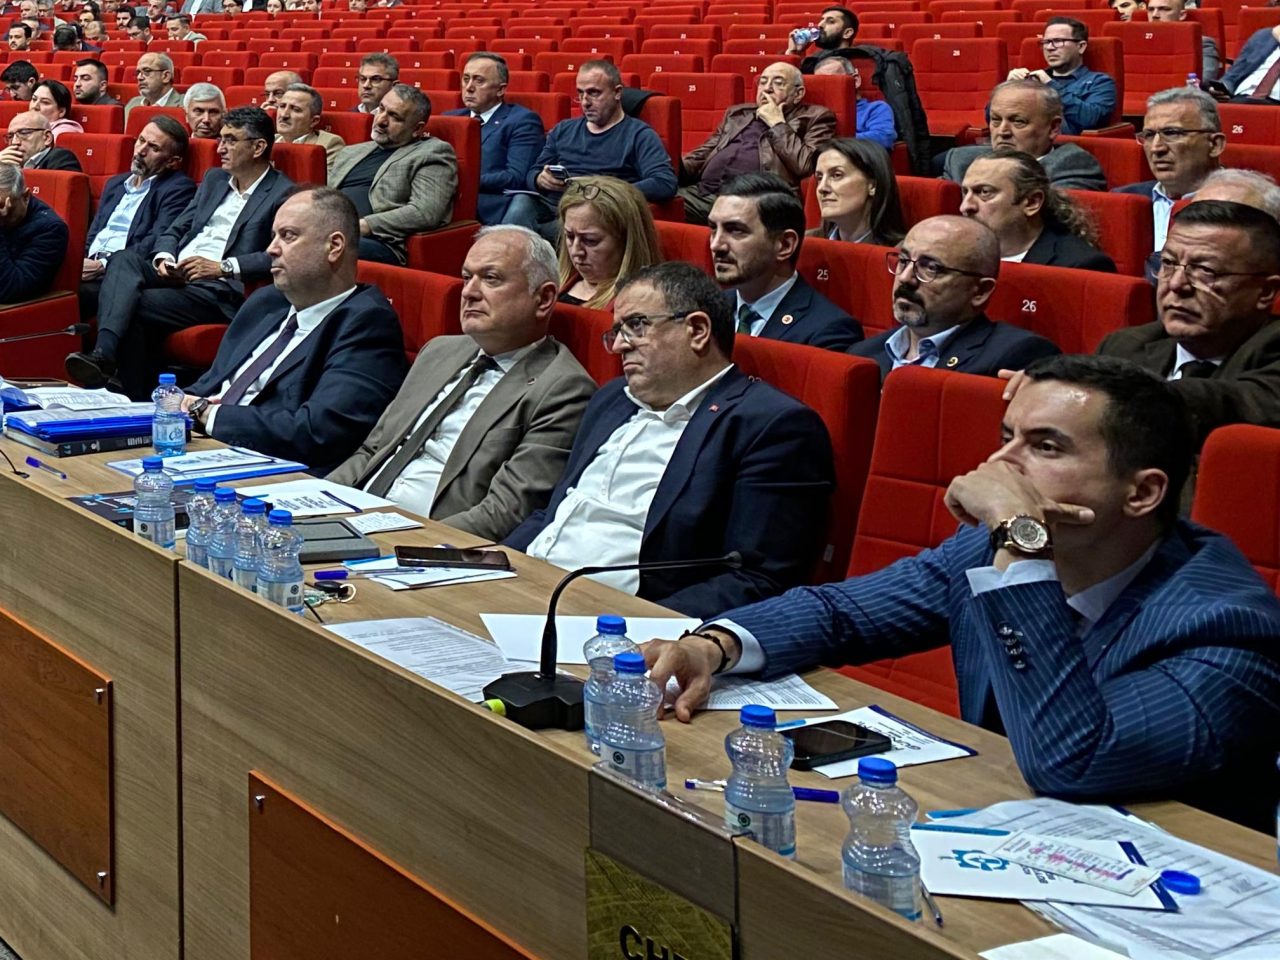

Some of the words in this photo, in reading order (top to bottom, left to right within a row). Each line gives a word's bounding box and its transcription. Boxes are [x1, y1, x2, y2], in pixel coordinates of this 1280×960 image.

[1231, 124, 1244, 134] 26
[816, 268, 829, 281] 25
[1021, 299, 1037, 313] 26
[620, 925, 688, 960] CH
